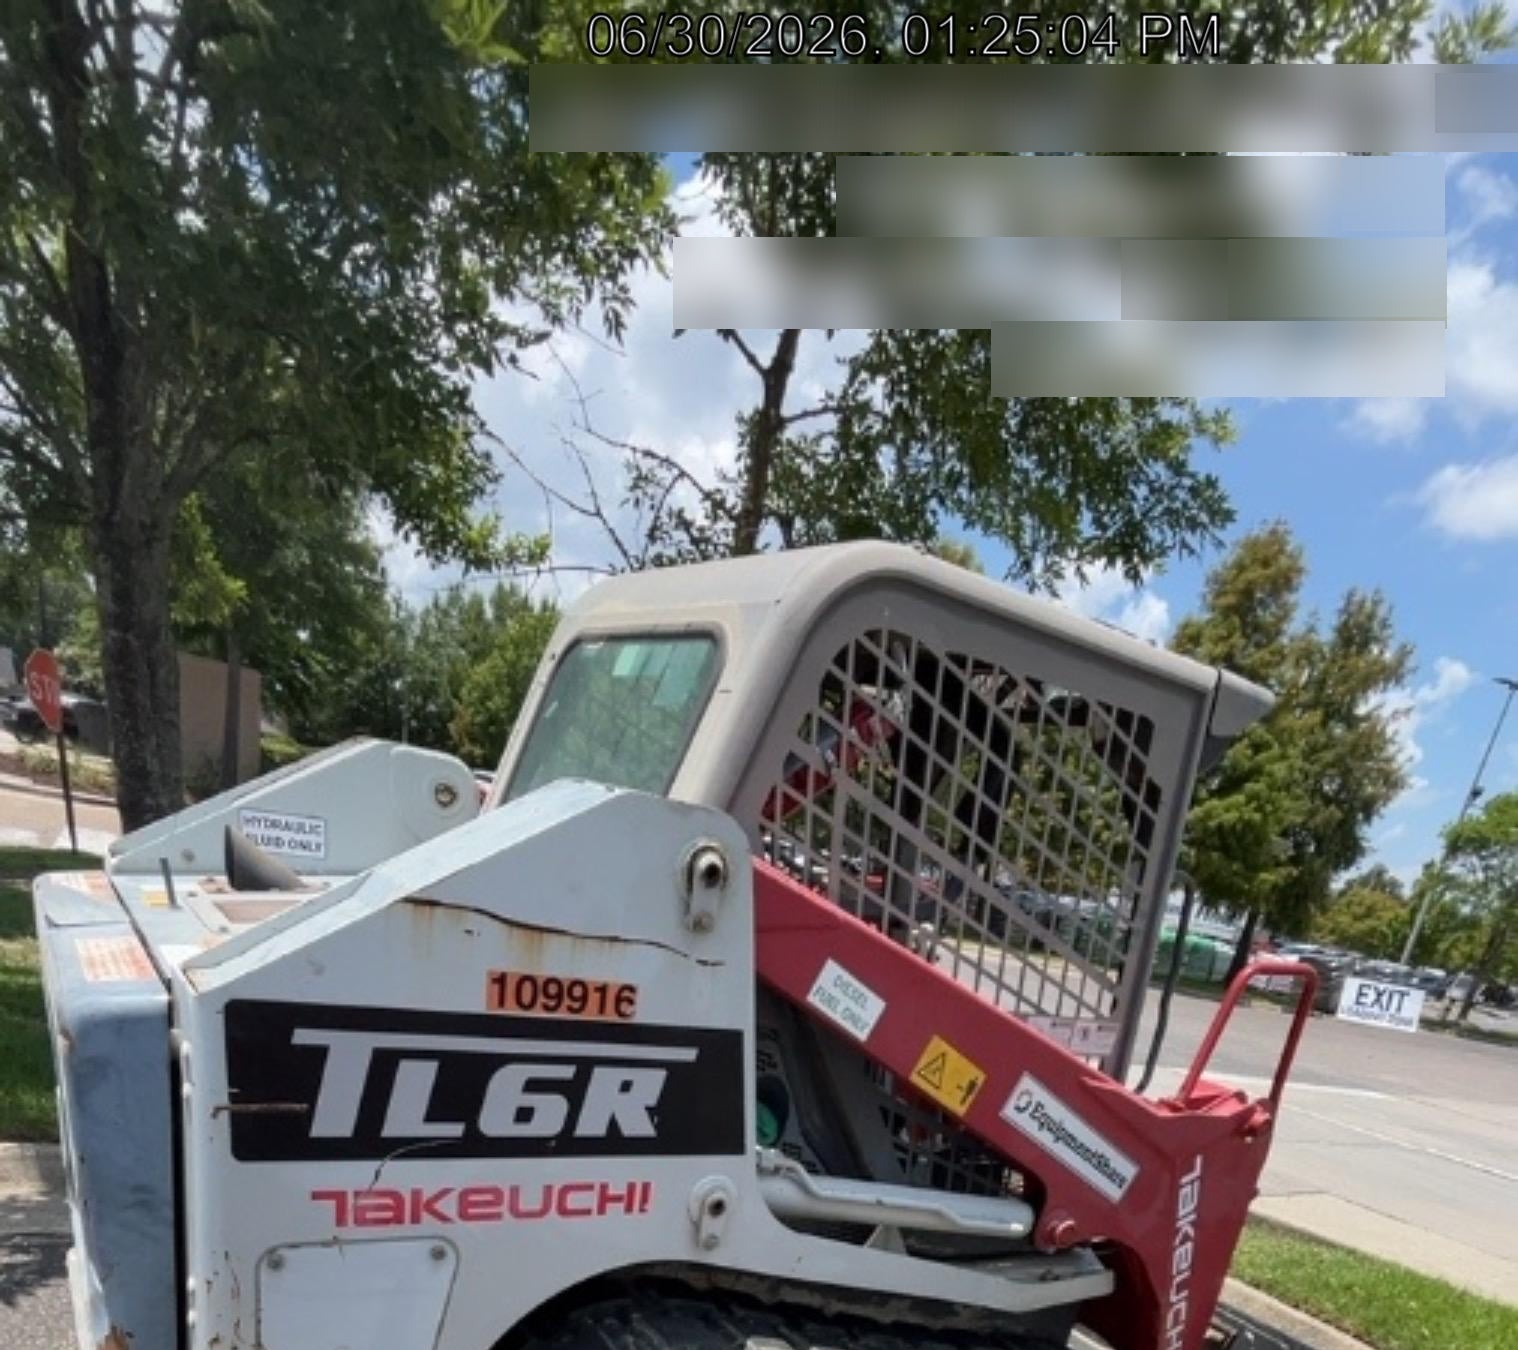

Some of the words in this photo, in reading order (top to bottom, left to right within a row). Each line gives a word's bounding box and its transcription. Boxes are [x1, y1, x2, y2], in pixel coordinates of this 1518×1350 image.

[242, 816, 323, 837] HYDRAULIC
[288, 838, 322, 853] ONLY
[491, 972, 637, 1019] 109916
[1355, 983, 1410, 1012] EXIT
[290, 1027, 698, 1139] TL6R
[1028, 1100, 1127, 1190] EquipmentShare
